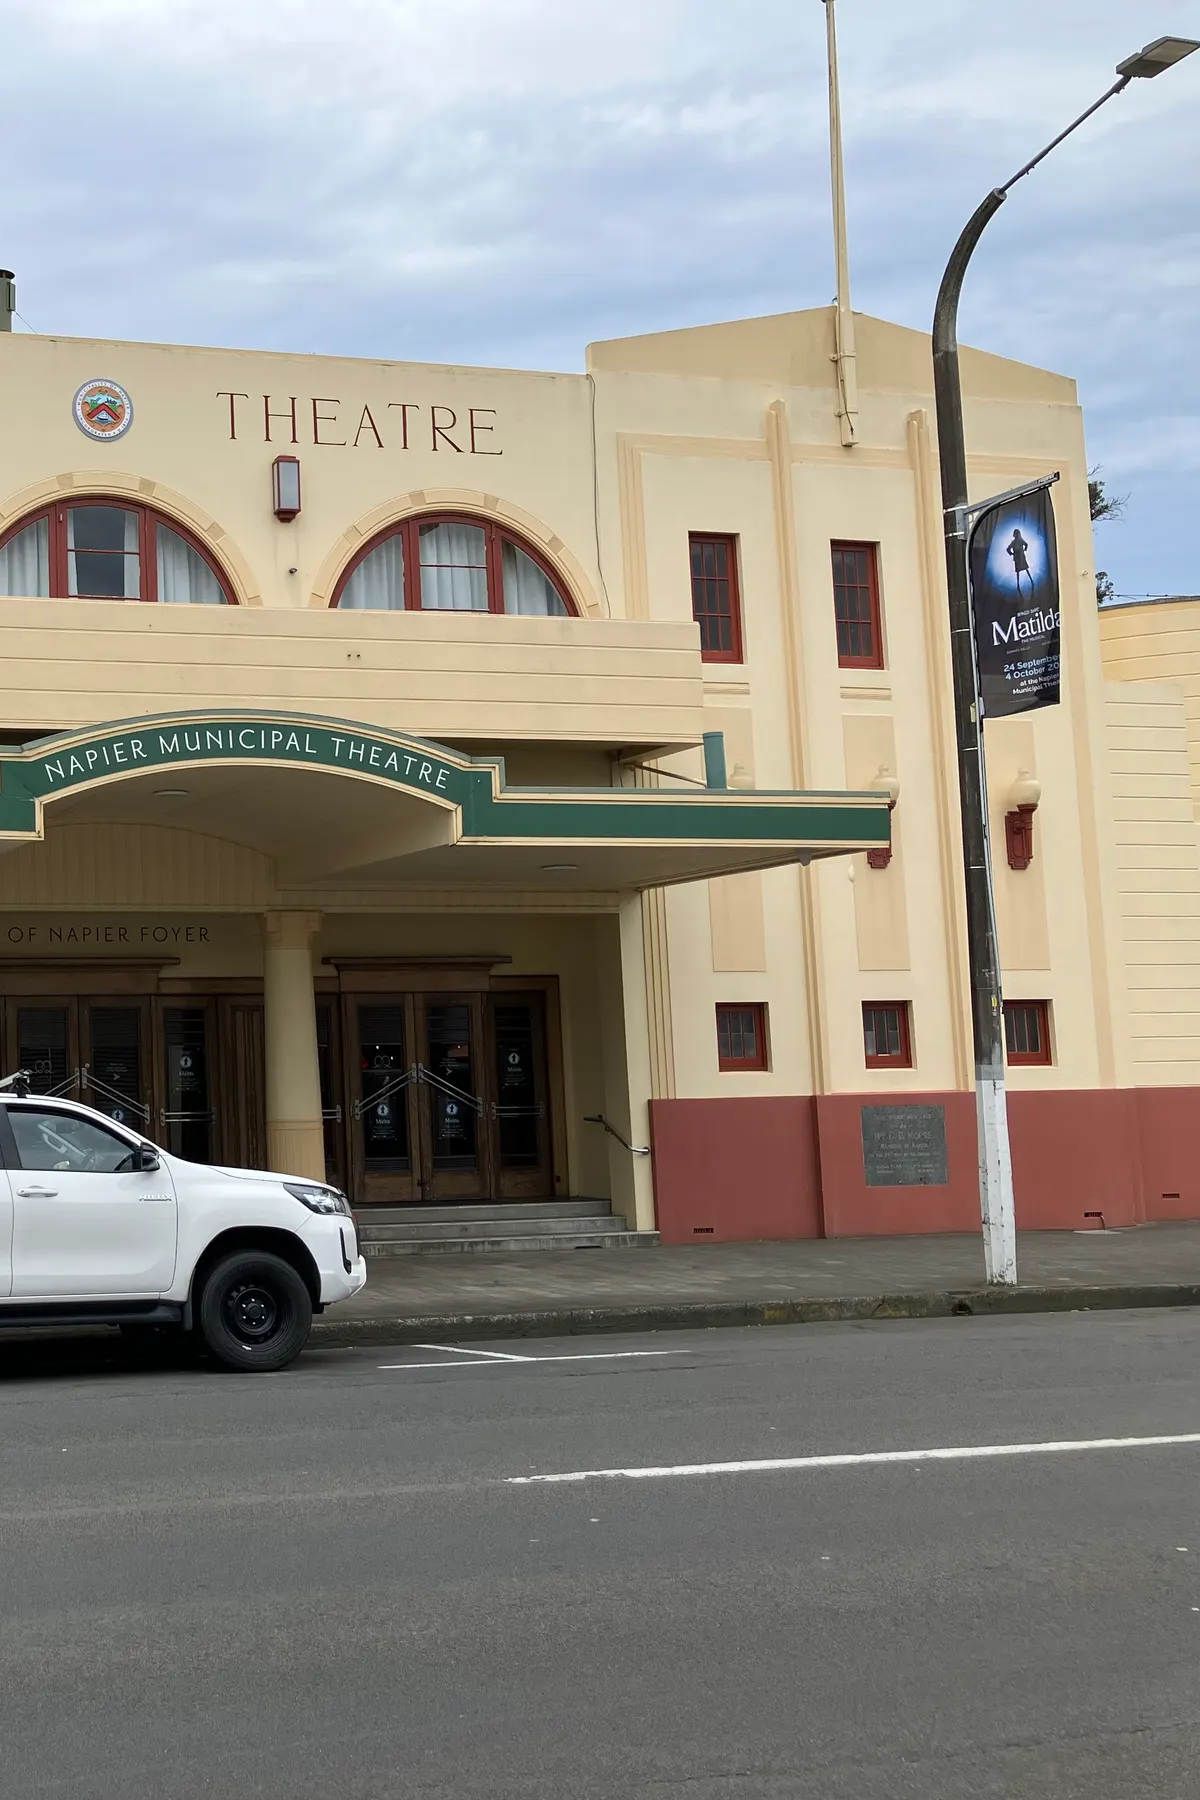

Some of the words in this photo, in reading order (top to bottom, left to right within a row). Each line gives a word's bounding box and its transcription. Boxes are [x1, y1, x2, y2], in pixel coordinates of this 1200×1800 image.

[215, 391, 504, 456] THEATRE
[991, 608, 1060, 646] Matilda
[1003, 663, 1015, 673] 24
[1017, 654, 1060, 671] Septembe
[1005, 672, 1012, 680] 4
[1013, 666, 1045, 679] October
[1027, 678, 1038, 686] the
[1012, 684, 1043, 695] Municipal
[44, 738, 148, 783] NAPIER
[158, 728, 318, 755] MUNICIPAL
[330, 736, 451, 789] THEATRE
[7, 926, 37, 943] OF
[49, 926, 130, 943] NAPIER
[140, 926, 211, 943] FOYER
